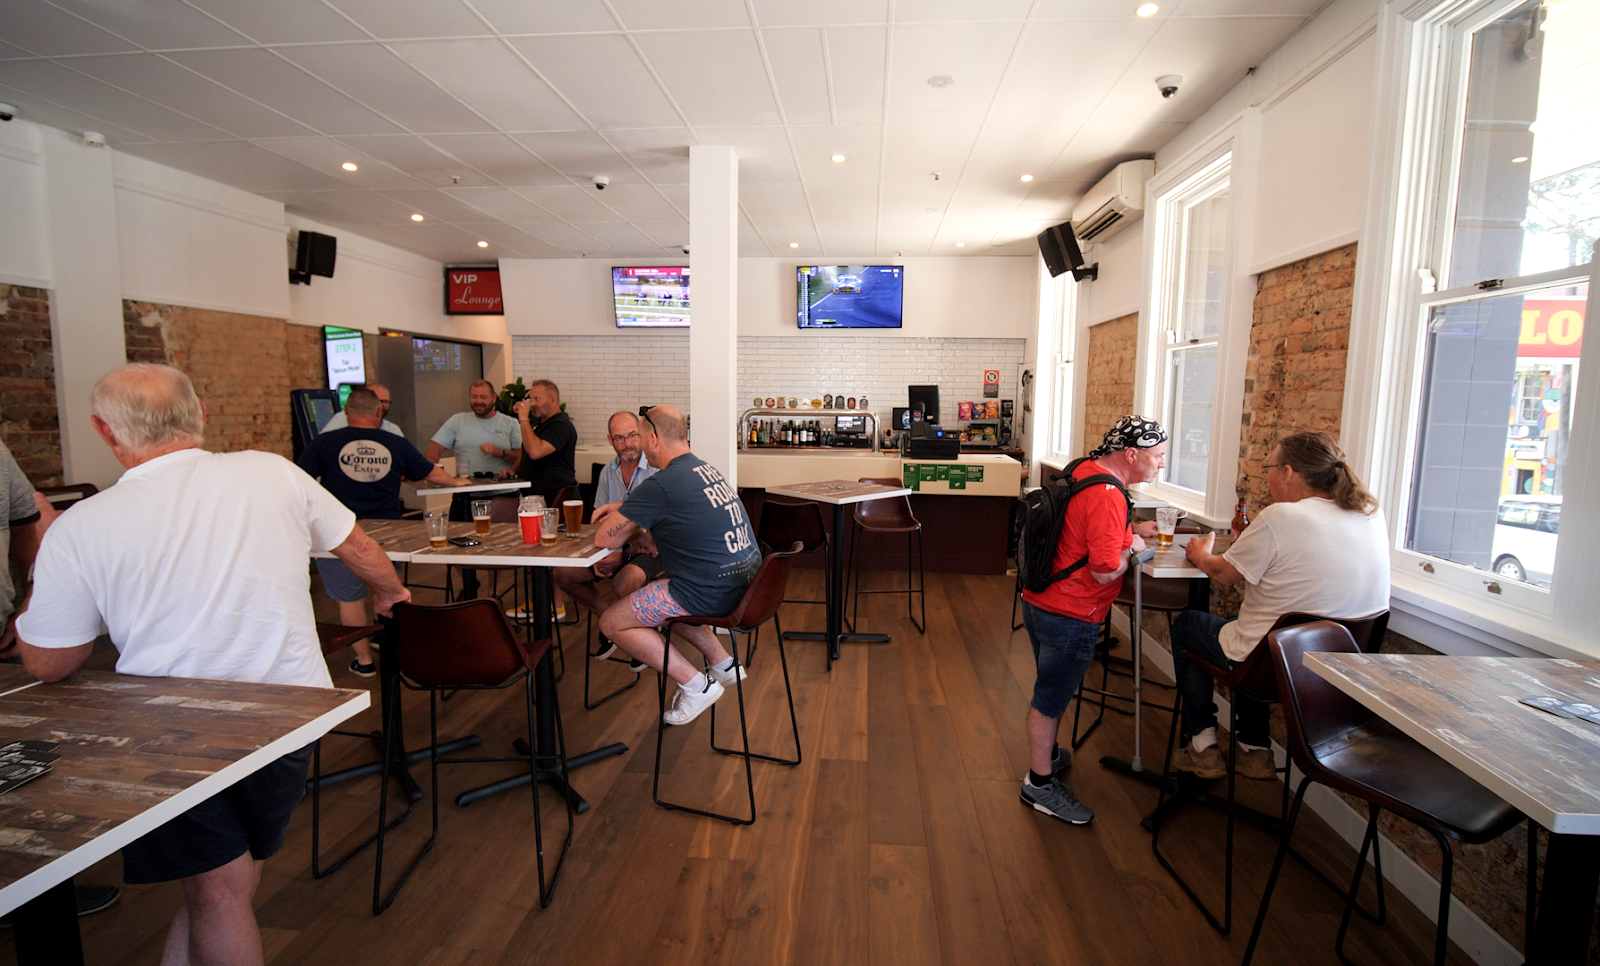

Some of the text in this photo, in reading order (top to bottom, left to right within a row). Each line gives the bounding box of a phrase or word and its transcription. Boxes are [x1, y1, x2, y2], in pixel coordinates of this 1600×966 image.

[452, 273, 478, 284] VIP
[454, 285, 500, 309] Lounge
[1518, 309, 1584, 346] LO
[335, 344, 351, 354] STEP
[340, 453, 388, 467] Corona
[354, 464, 380, 474] Extra
[692, 464, 723, 485] THE
[724, 502, 743, 527] TO
